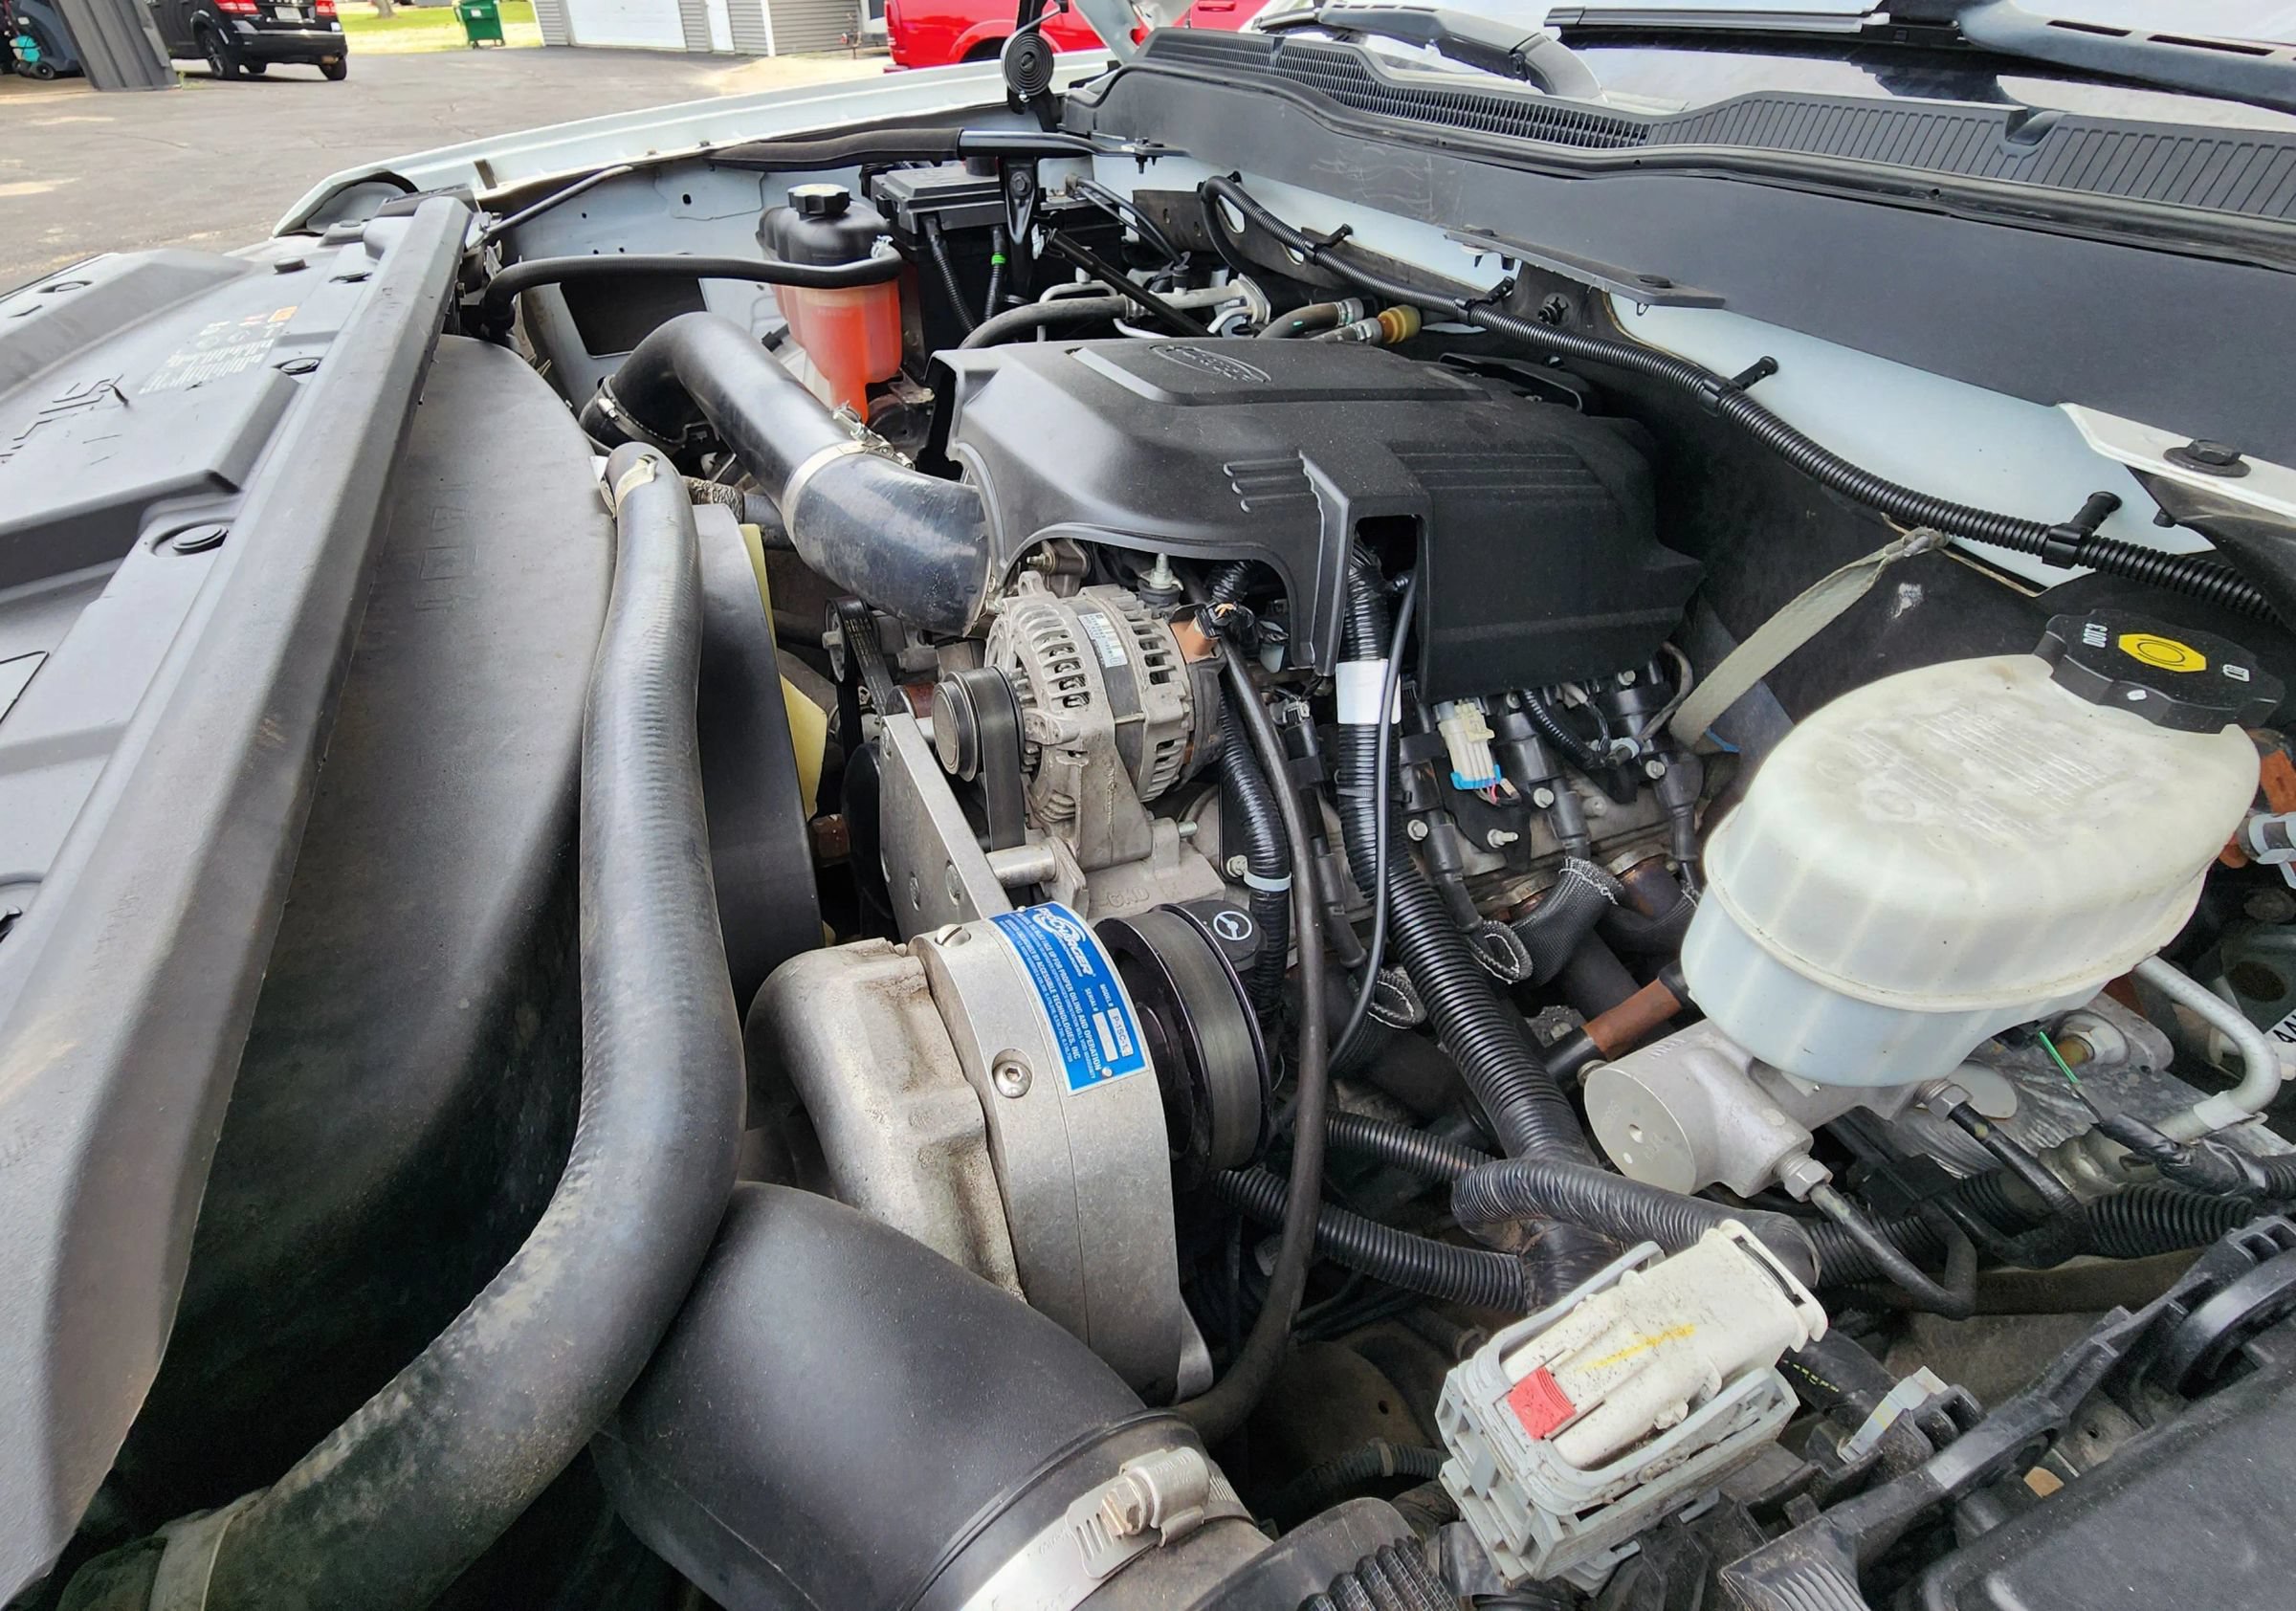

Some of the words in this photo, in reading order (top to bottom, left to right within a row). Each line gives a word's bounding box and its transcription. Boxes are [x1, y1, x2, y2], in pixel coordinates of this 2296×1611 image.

[1051, 958, 1065, 970] FOR
[1057, 968, 1075, 993] PROPER
[1069, 991, 1084, 1014] OILING
[1099, 983, 1113, 1003] MODEL
[1077, 1013, 1089, 1029] AND
[1071, 1046, 1081, 1060] INC
[1083, 1029, 1102, 1071] OPERATION
